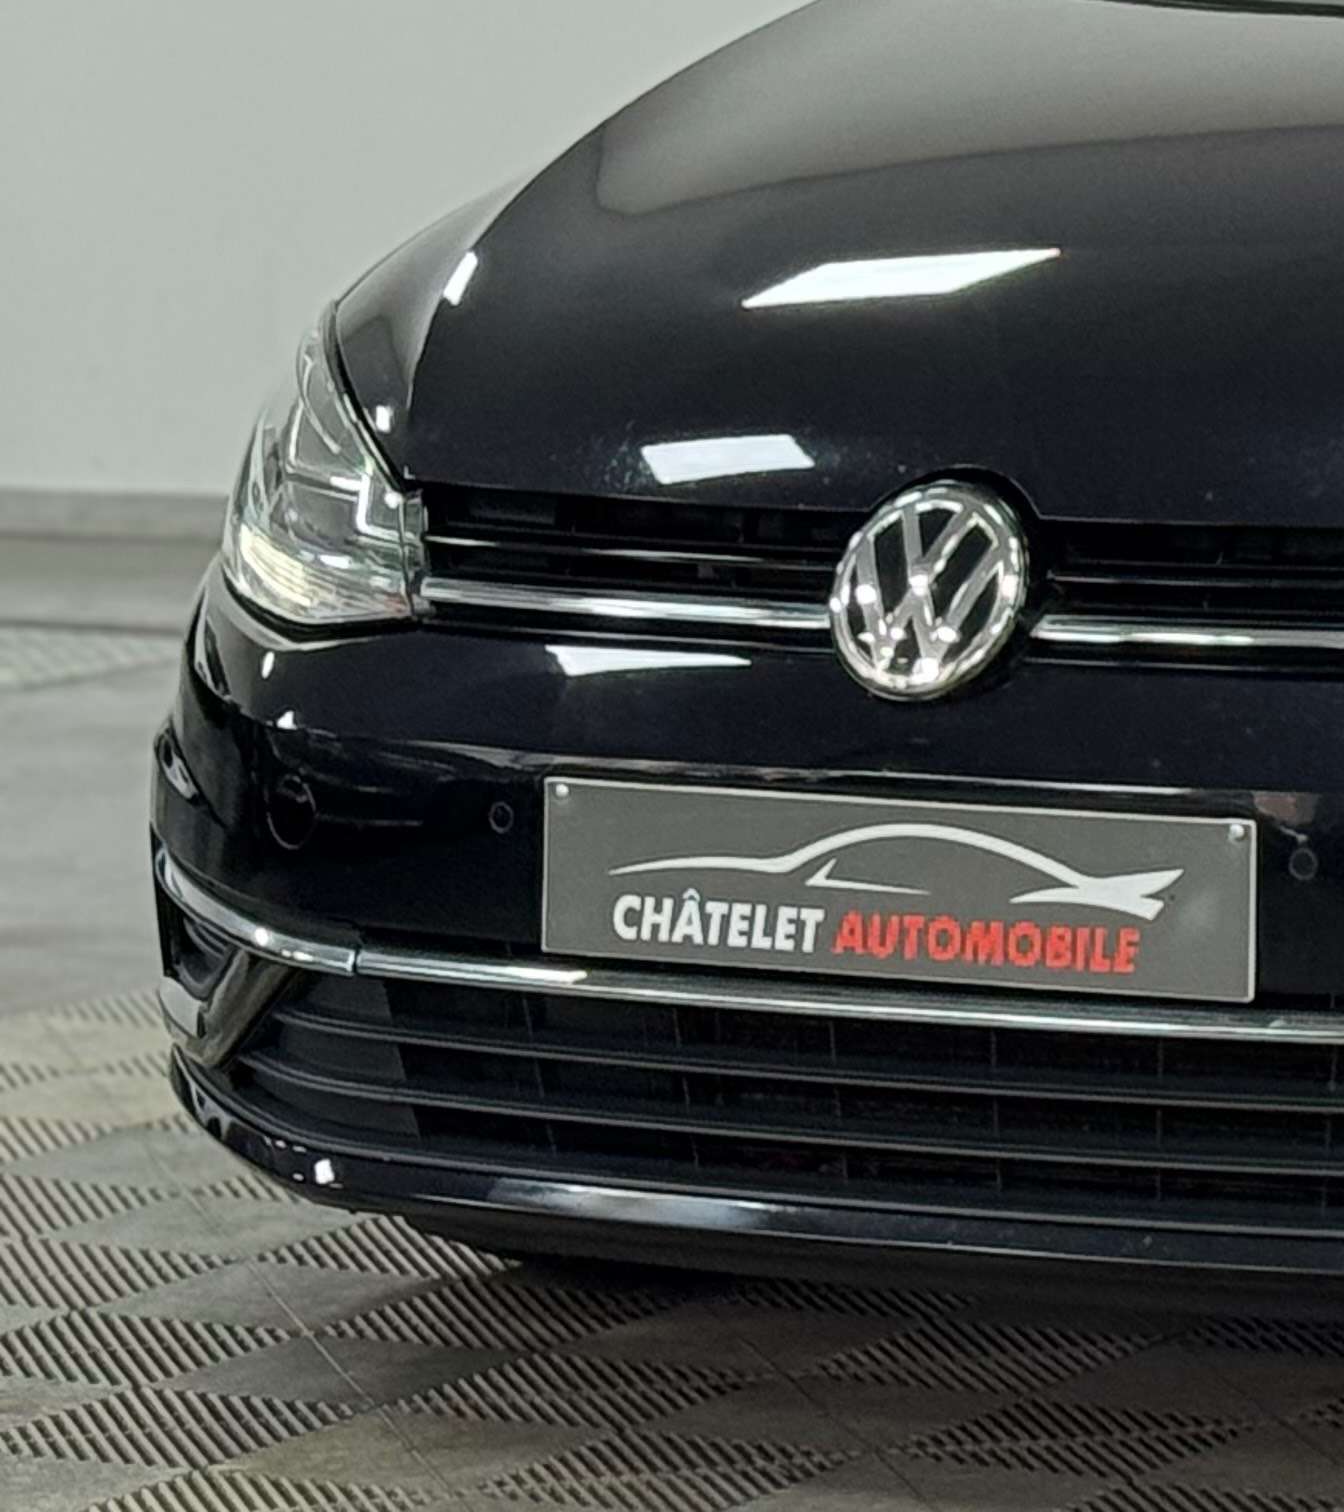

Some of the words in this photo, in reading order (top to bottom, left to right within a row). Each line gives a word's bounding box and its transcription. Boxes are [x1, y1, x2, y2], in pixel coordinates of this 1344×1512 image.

[836, 482, 1025, 694] VW
[613, 889, 824, 953] CHÂTELET
[833, 911, 1141, 973] AUTOMOBILE
